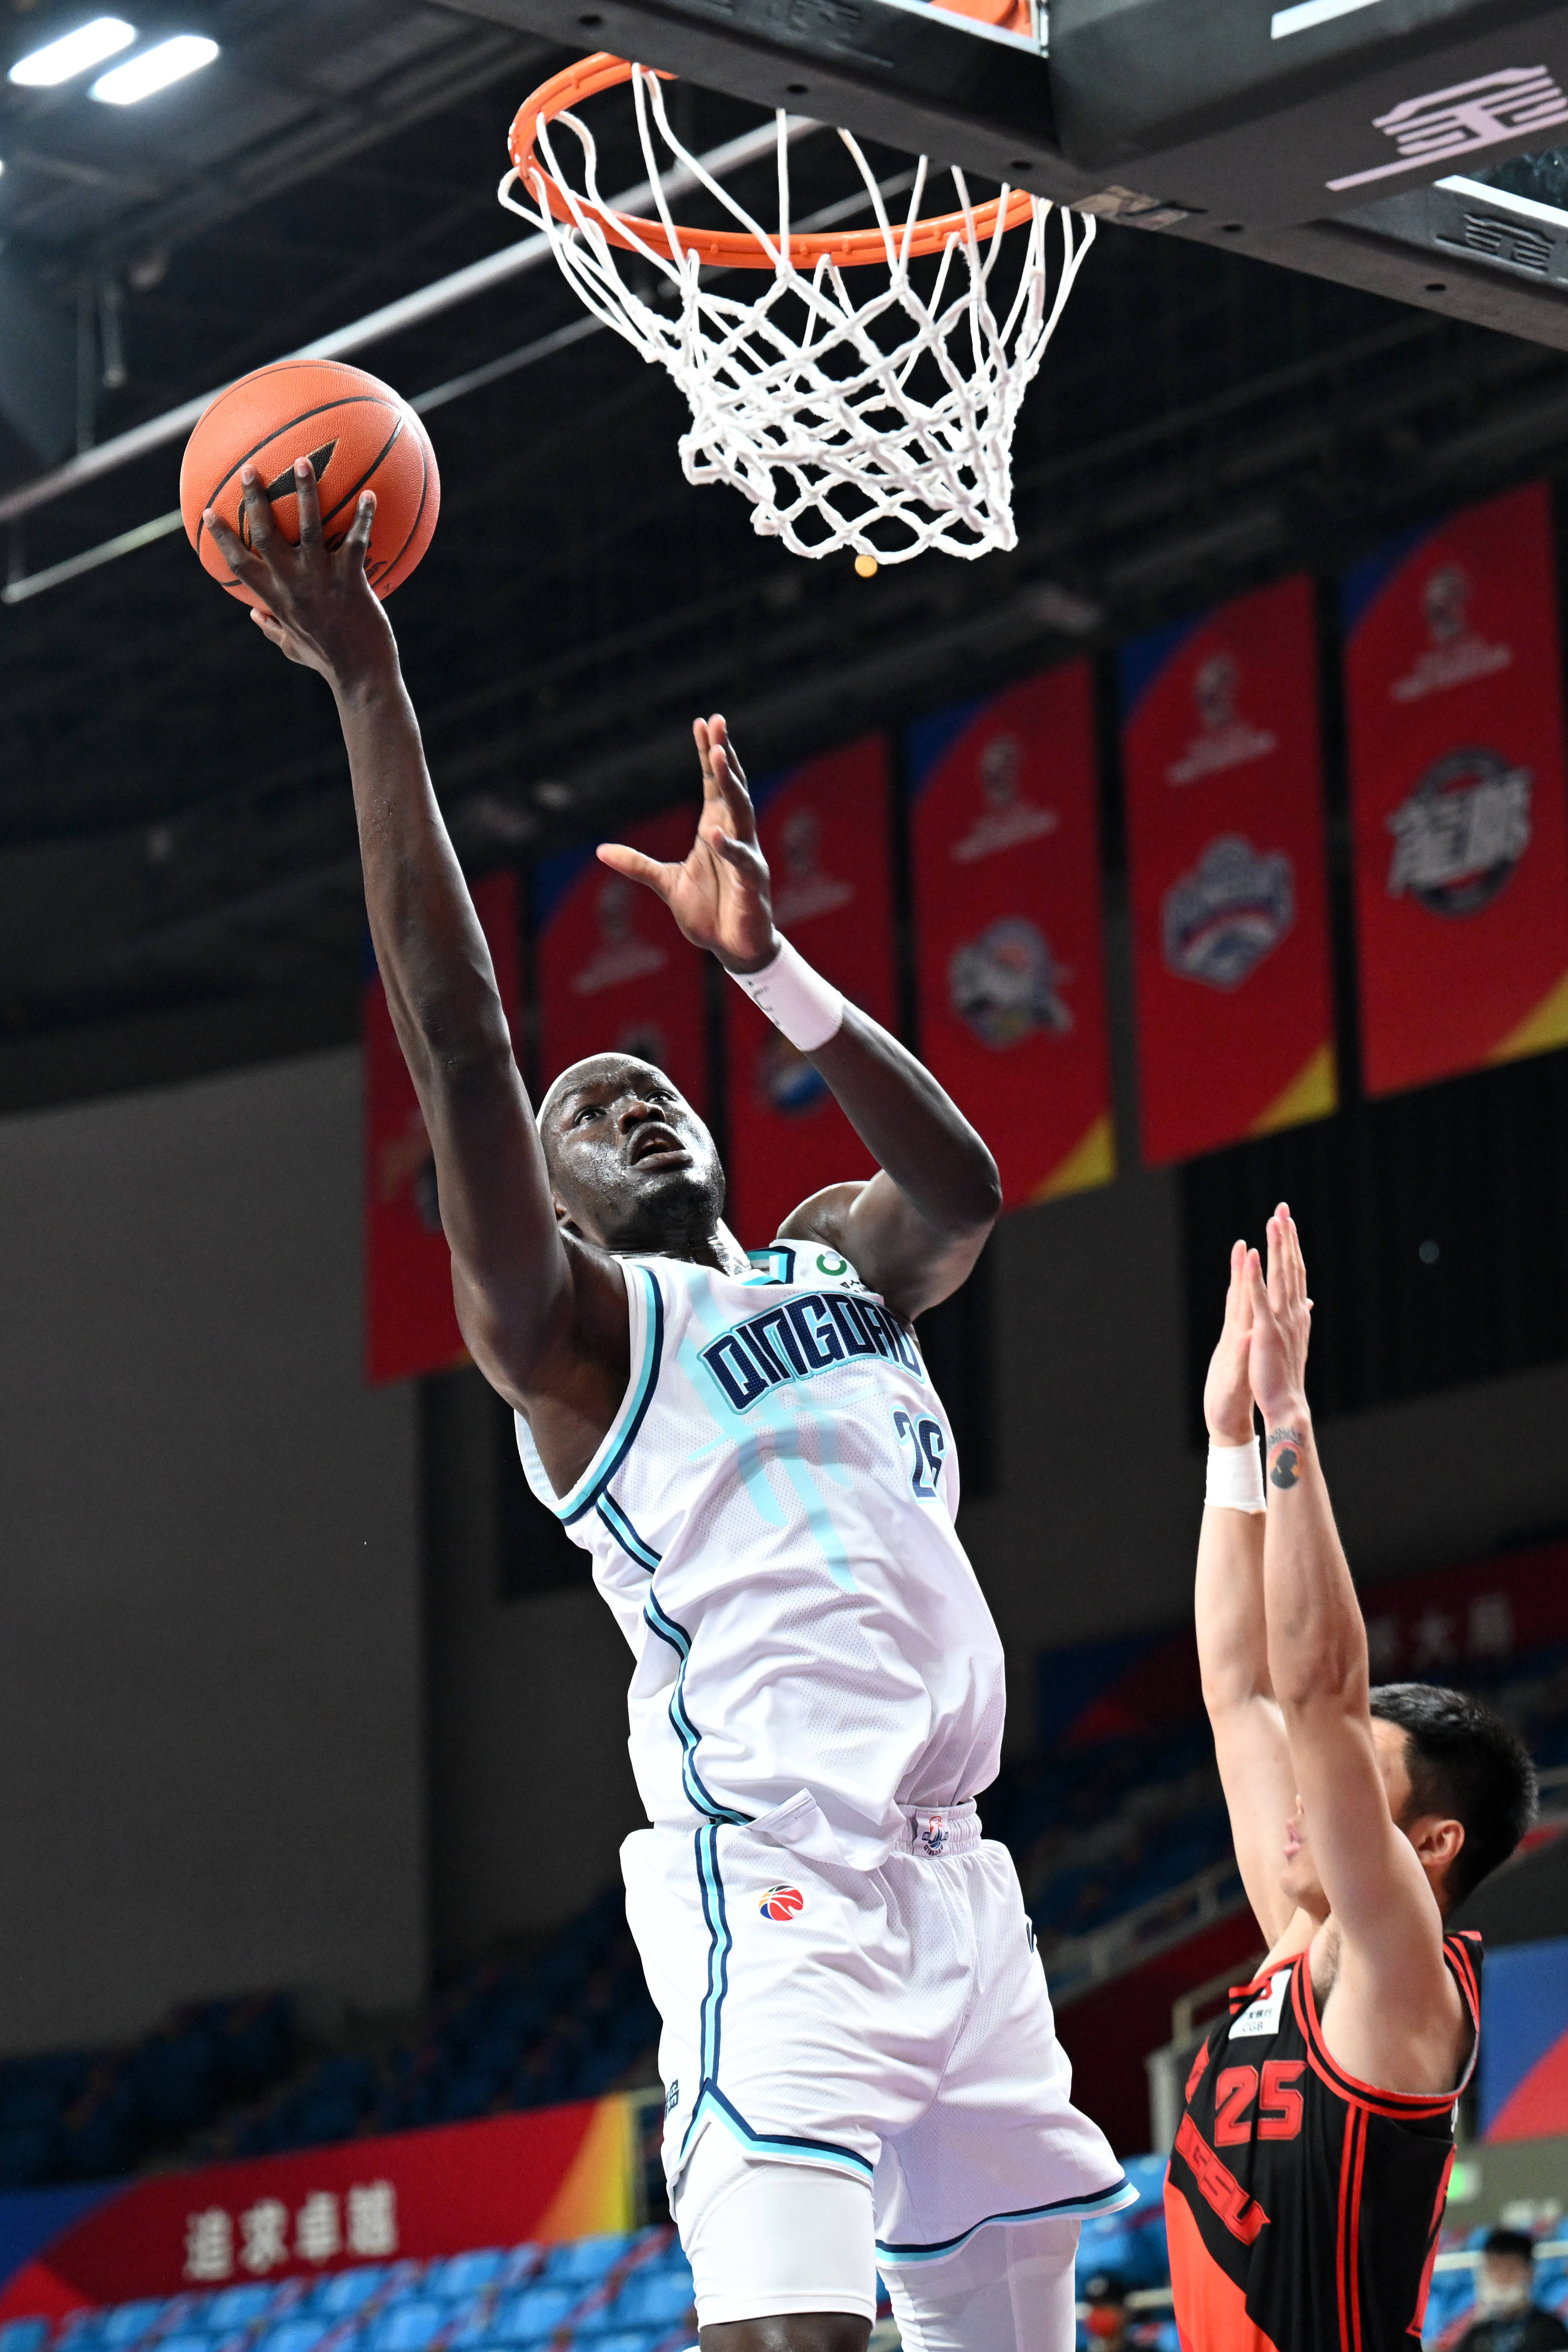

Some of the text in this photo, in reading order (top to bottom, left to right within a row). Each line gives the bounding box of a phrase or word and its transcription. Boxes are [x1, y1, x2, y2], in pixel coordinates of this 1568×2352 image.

[700, 1291, 923, 1412] QINGDAO
[892, 1409, 945, 1500] 26
[1214, 2060, 1307, 2148] 25
